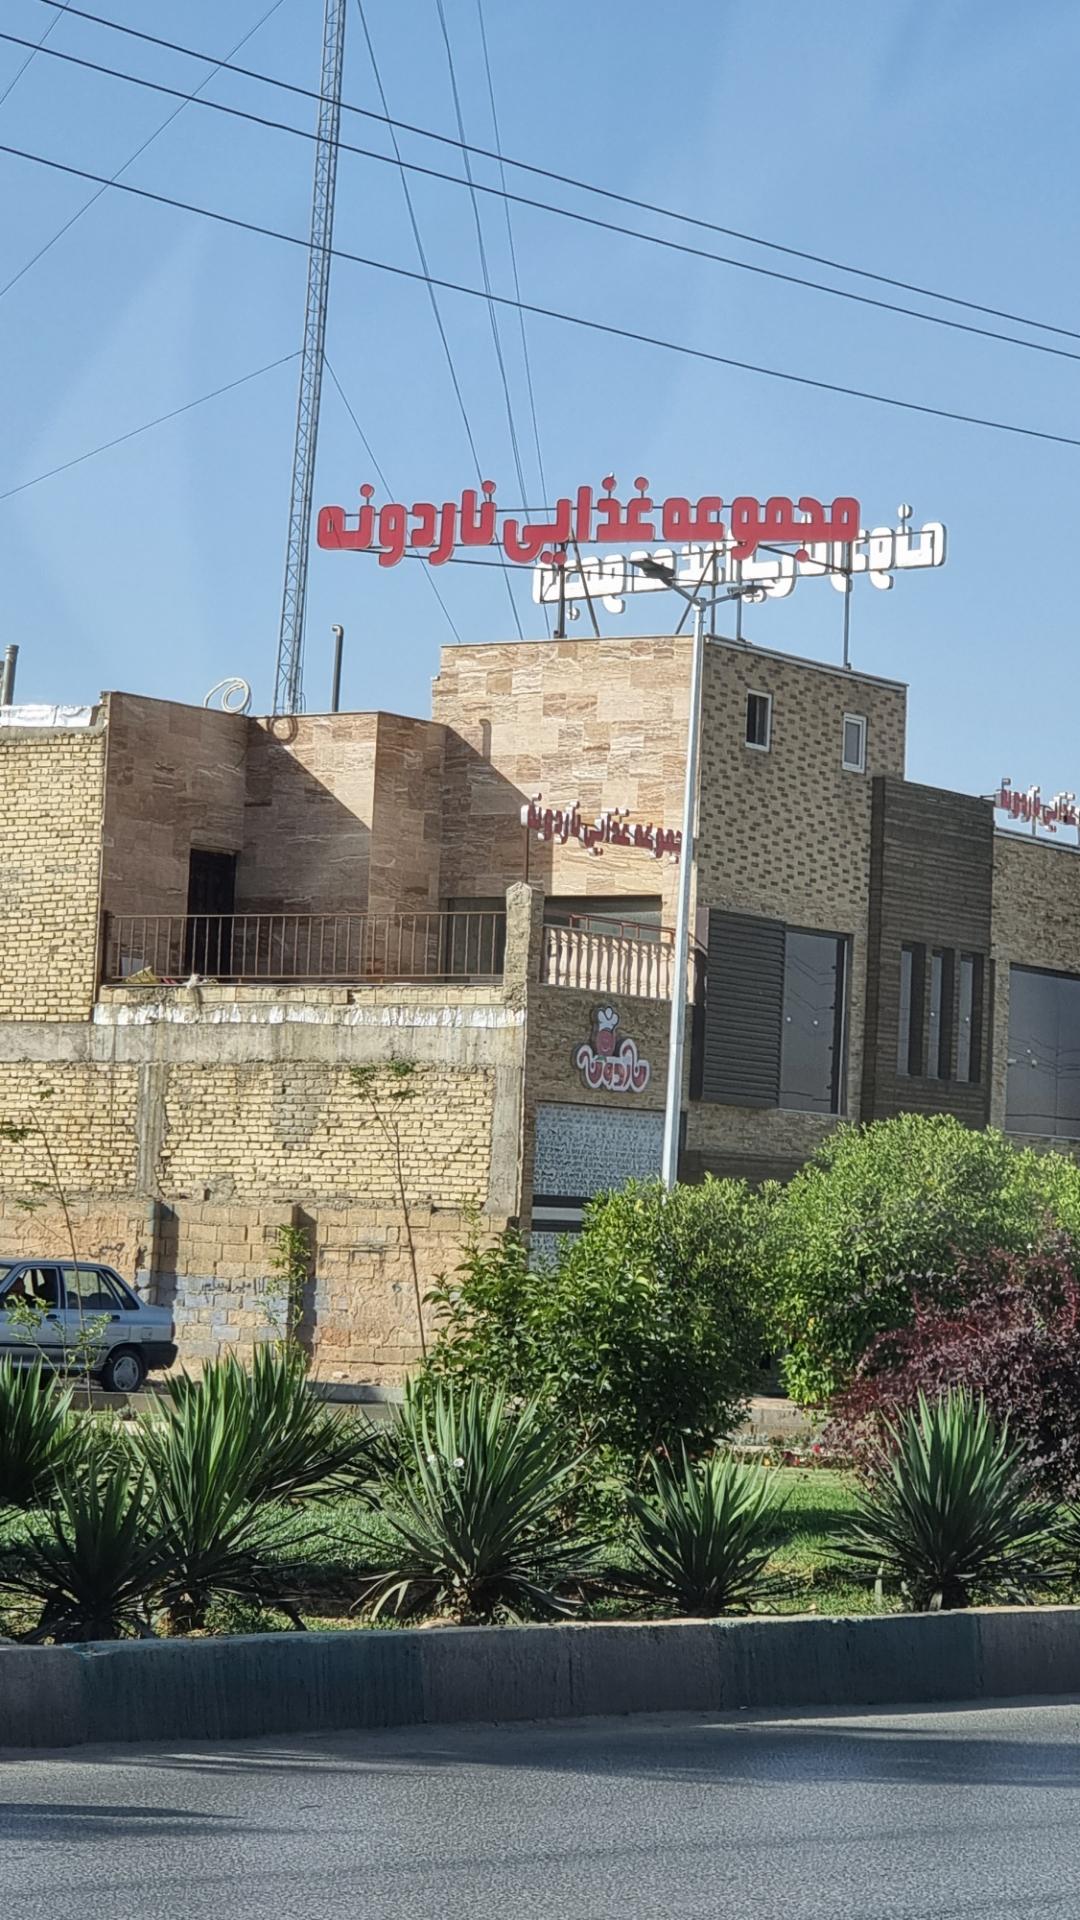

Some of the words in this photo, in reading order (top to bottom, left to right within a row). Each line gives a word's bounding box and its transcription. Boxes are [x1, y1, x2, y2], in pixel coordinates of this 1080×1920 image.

[317, 478, 497, 568] ناردونه
[503, 476, 656, 566] غذایی
[662, 496, 860, 563] مجموعه
